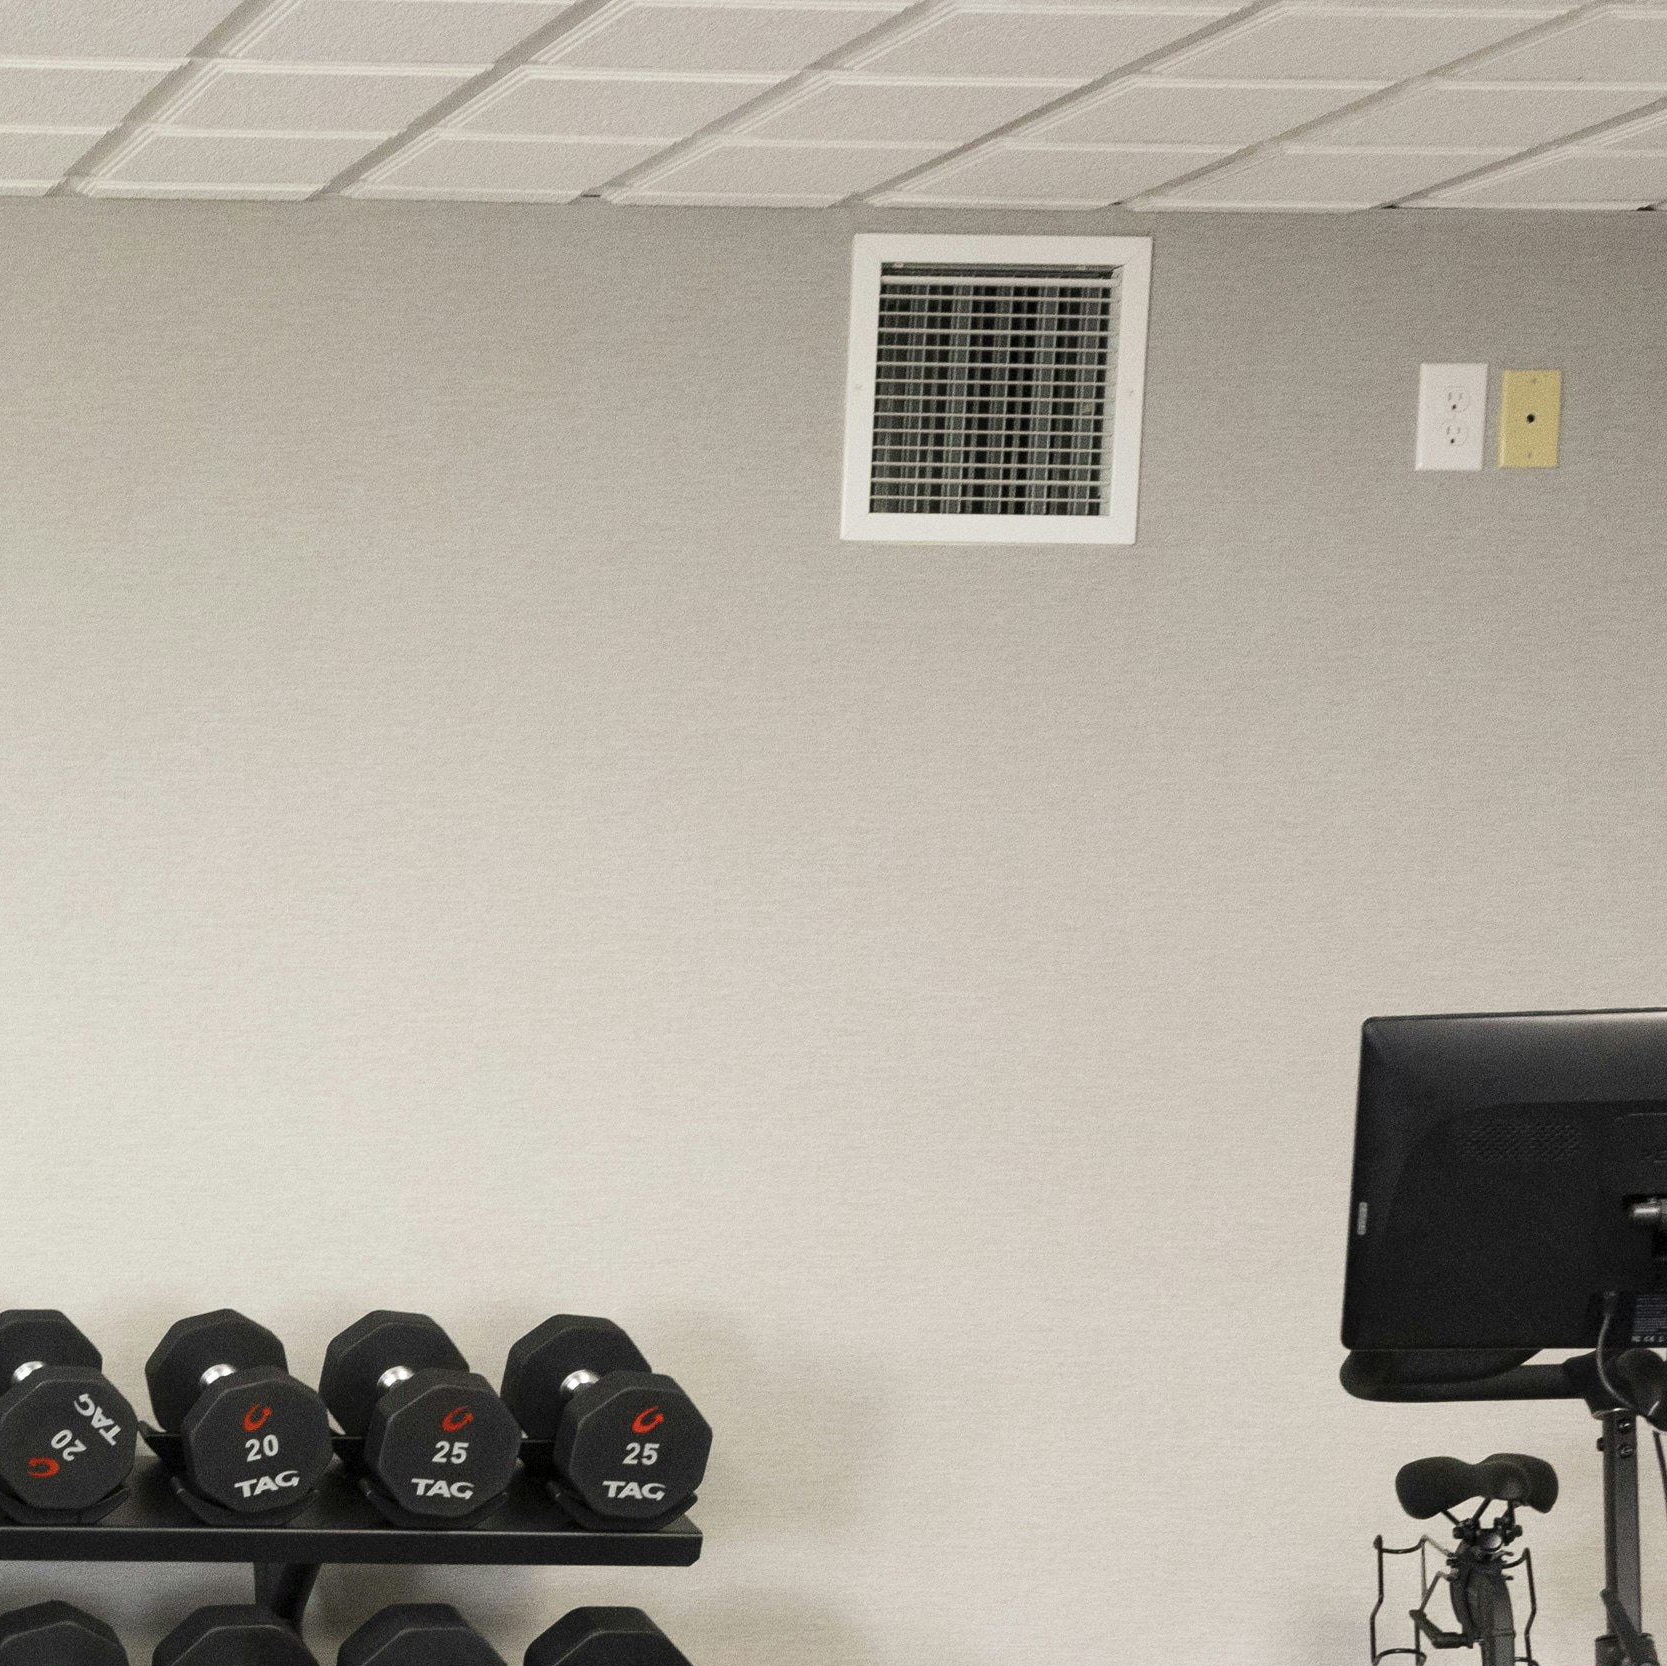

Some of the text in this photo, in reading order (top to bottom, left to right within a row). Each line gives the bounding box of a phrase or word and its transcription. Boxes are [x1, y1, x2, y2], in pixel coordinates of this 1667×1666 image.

[73, 1393, 122, 1447] TAG
[50, 1429, 87, 1462] 20
[244, 1434, 279, 1462] 20
[431, 1440, 470, 1465] 25
[622, 1442, 660, 1466] 25
[234, 1470, 300, 1498] TAG
[411, 1478, 474, 1500] TAG
[602, 1480, 666, 1501] TAG
